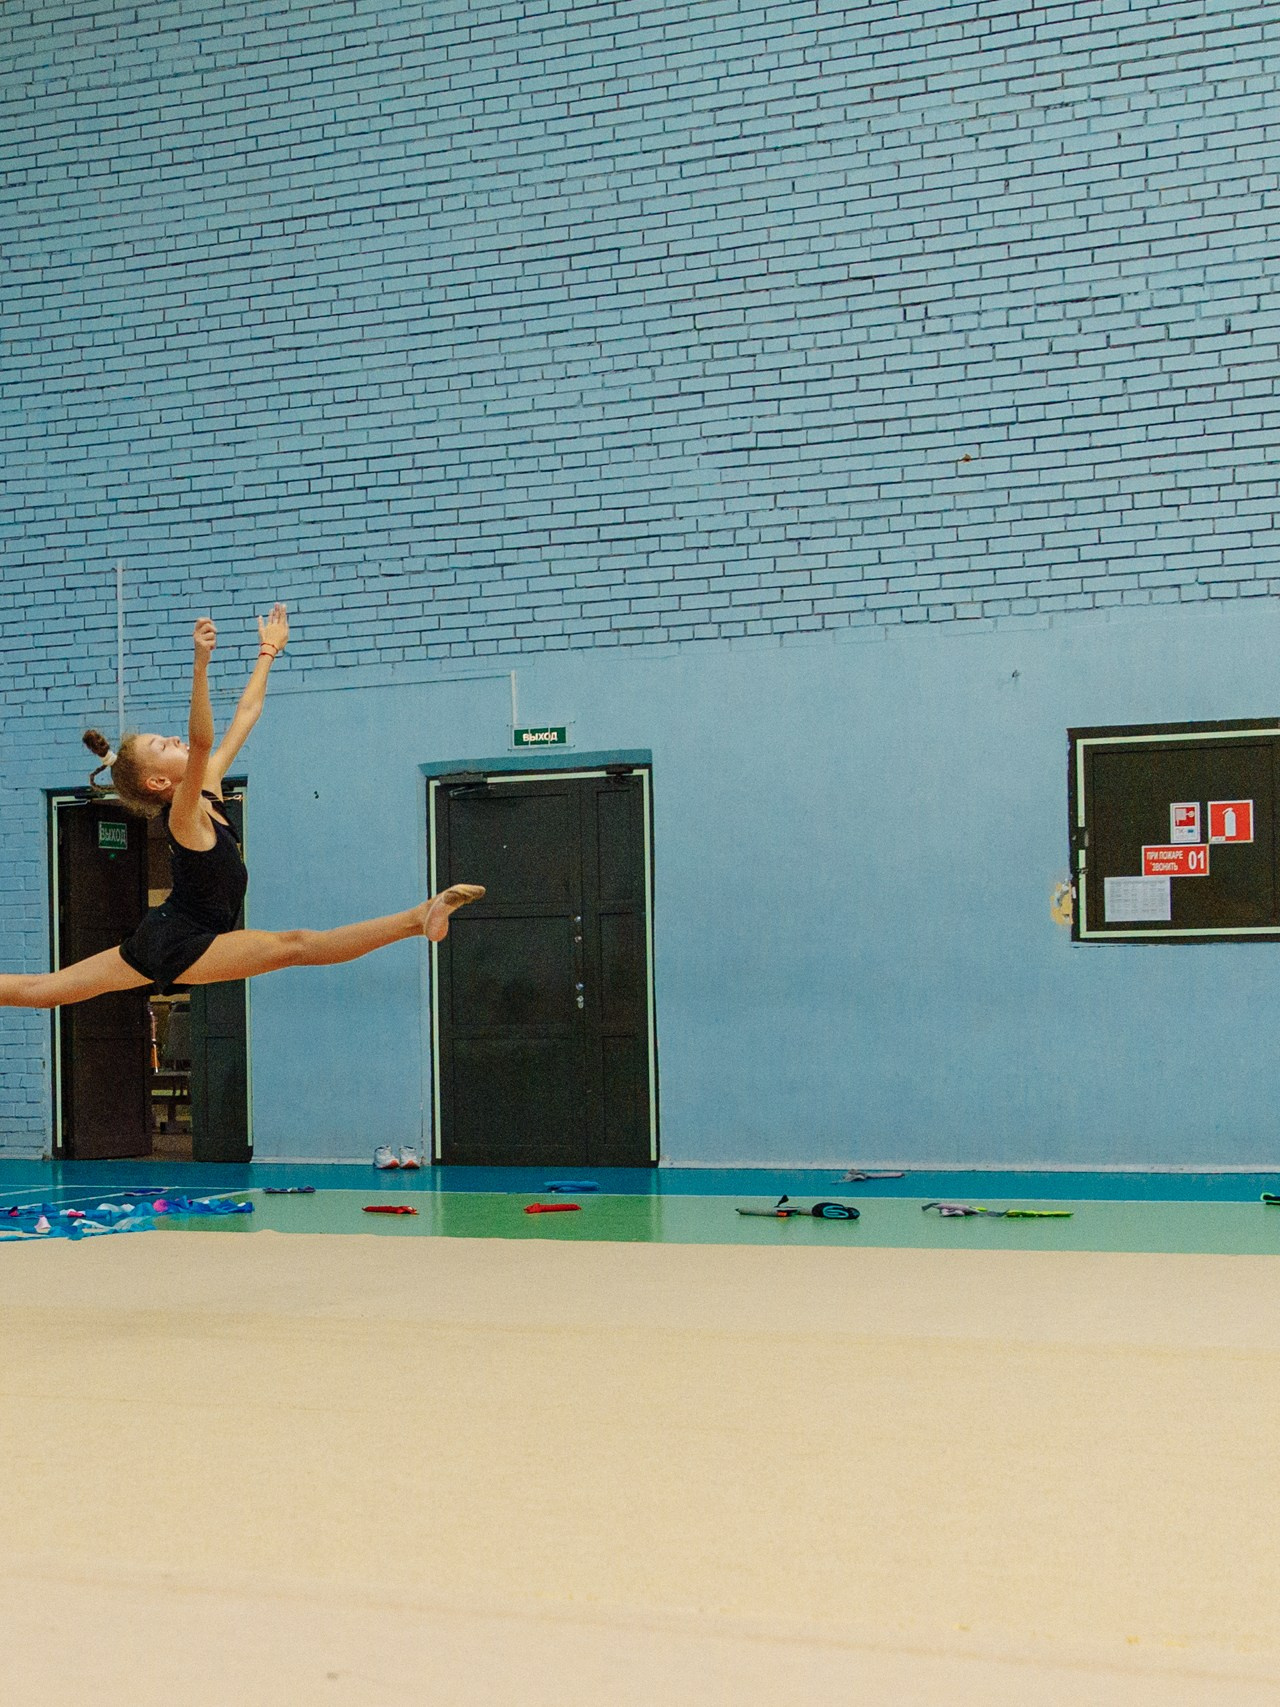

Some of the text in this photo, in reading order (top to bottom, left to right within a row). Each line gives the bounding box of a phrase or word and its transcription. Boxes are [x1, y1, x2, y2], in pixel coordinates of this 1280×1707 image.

[522, 731, 558, 742] ВЫХОД
[100, 827, 126, 844] ВЫХОД
[1146, 850, 1184, 860] ПРИ ПОЖАРЕ
[1188, 850, 1205, 870] 01
[1151, 862, 1179, 872] ЗВОНИТЬ
